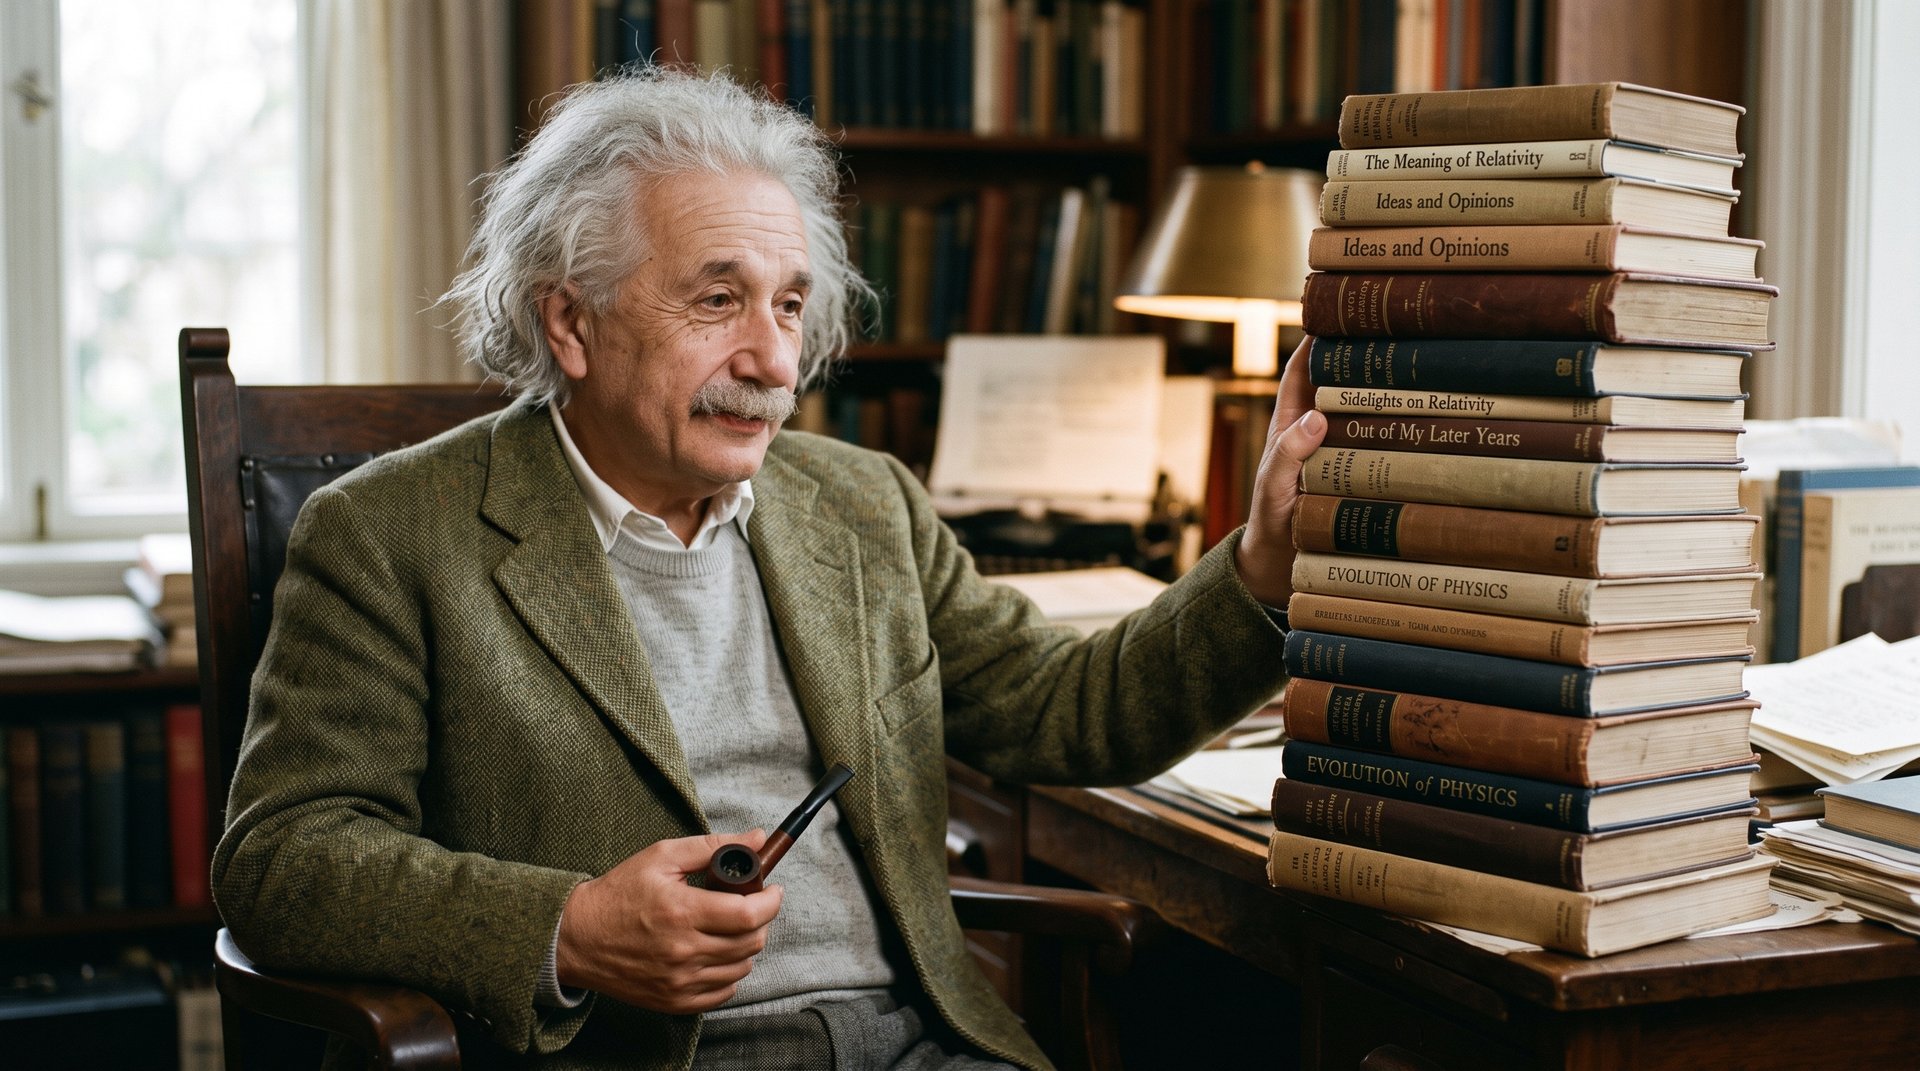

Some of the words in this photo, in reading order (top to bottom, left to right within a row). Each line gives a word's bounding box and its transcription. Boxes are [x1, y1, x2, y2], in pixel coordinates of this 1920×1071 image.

[1365, 154, 1389, 170] The
[1394, 153, 1452, 172] Meaning
[1457, 151, 1472, 168] of
[1475, 149, 1544, 170] Relativity
[1376, 193, 1412, 210] Ideas
[1417, 192, 1443, 209] and
[1448, 192, 1514, 212] Opinions
[1343, 238, 1386, 257] Ideas
[1392, 238, 1423, 257] and
[1430, 237, 1509, 262] Opinions
[1340, 391, 1403, 411] Sidelights
[1407, 397, 1423, 409] on
[1428, 394, 1495, 415] Relativity
[1346, 421, 1375, 440] Out
[1380, 422, 1396, 440] of
[1400, 423, 1424, 445] My
[1429, 425, 1471, 444] Later
[1476, 427, 1520, 447] Years
[1322, 459, 1331, 481] THE
[1327, 566, 1412, 589] EVOLUTION
[1417, 576, 1439, 592] OF
[1443, 578, 1509, 600] PHYSICS
[1431, 624, 1448, 634] AND
[1307, 755, 1409, 789] EVOLUTION
[1415, 776, 1433, 796] of
[1439, 778, 1518, 807] PHYSICS
